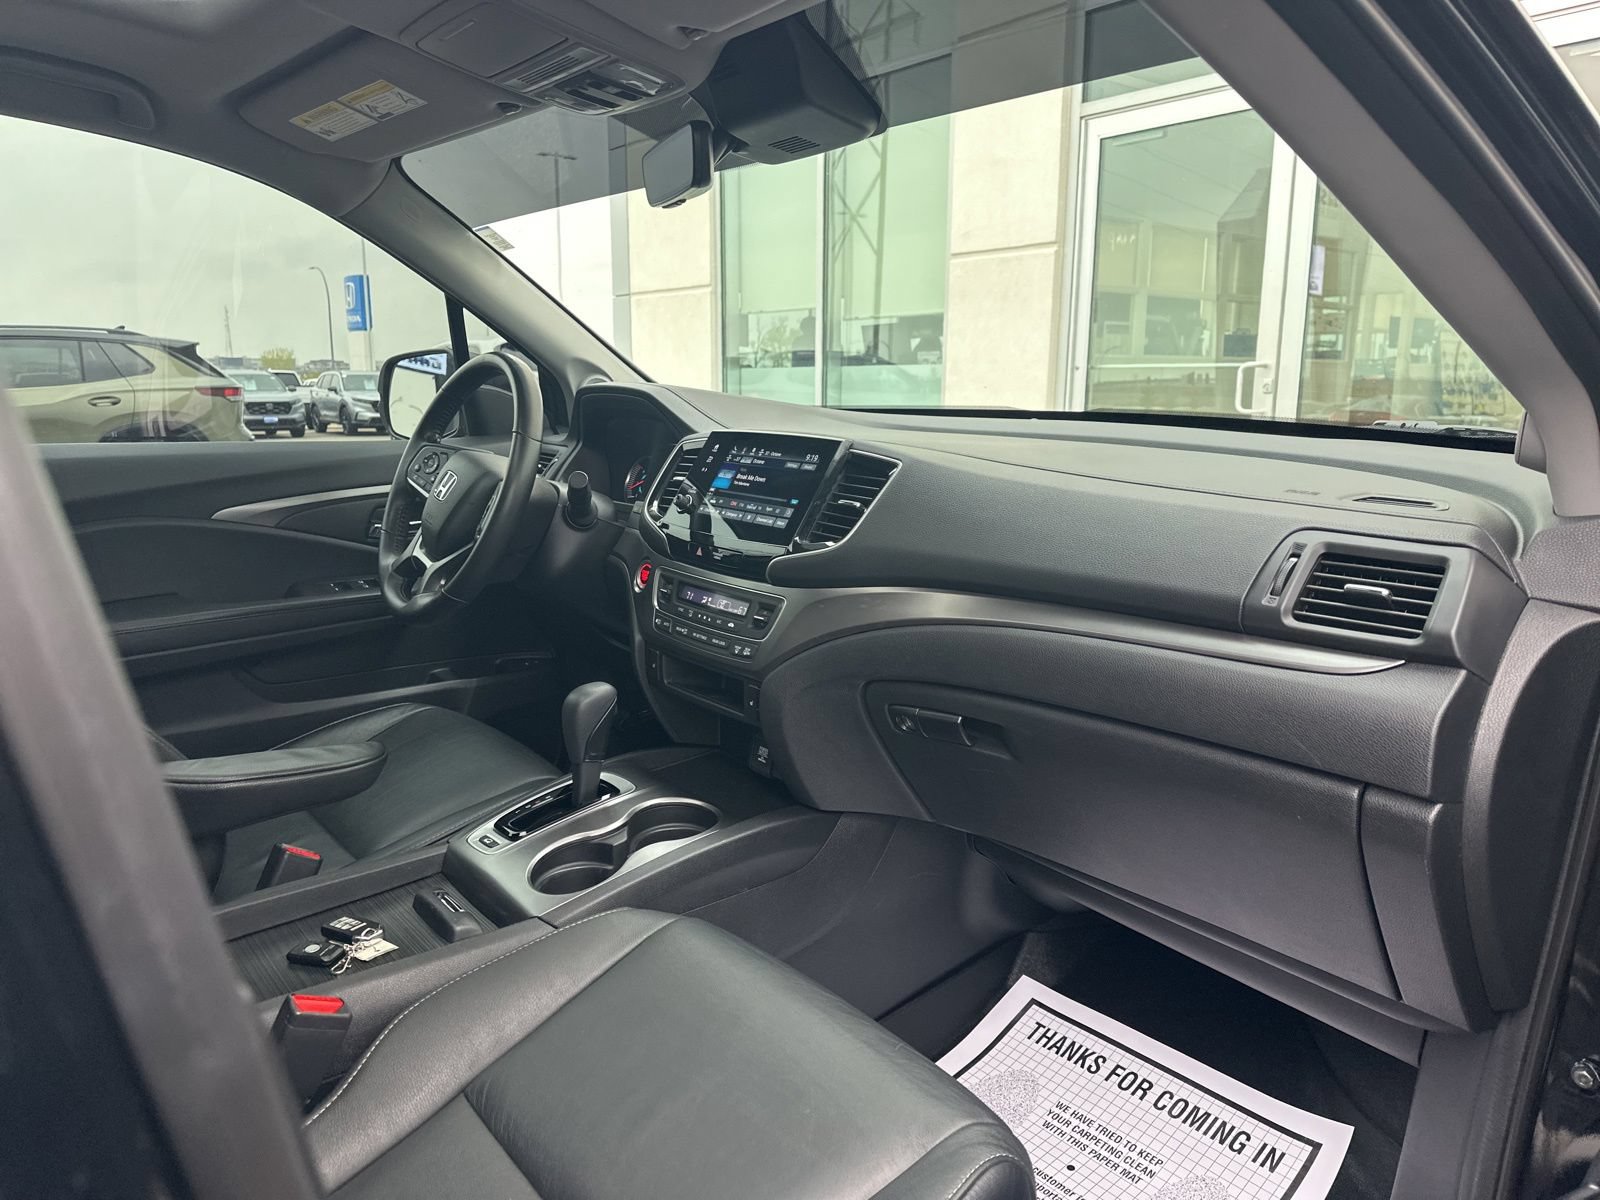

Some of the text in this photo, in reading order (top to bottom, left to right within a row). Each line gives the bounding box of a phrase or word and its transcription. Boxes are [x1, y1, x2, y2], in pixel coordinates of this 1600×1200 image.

[1027, 1021, 1286, 1174] THANKS FOR COMING IN
[1042, 1120, 1144, 1185] WITH THIS PAPER MAT
[1046, 1109, 1157, 1179] YOUR CARPETING CLEAN
[1055, 1101, 1164, 1167] WE HAVE TRIED TO KEEP
[1032, 1167, 1075, 1197] customer
